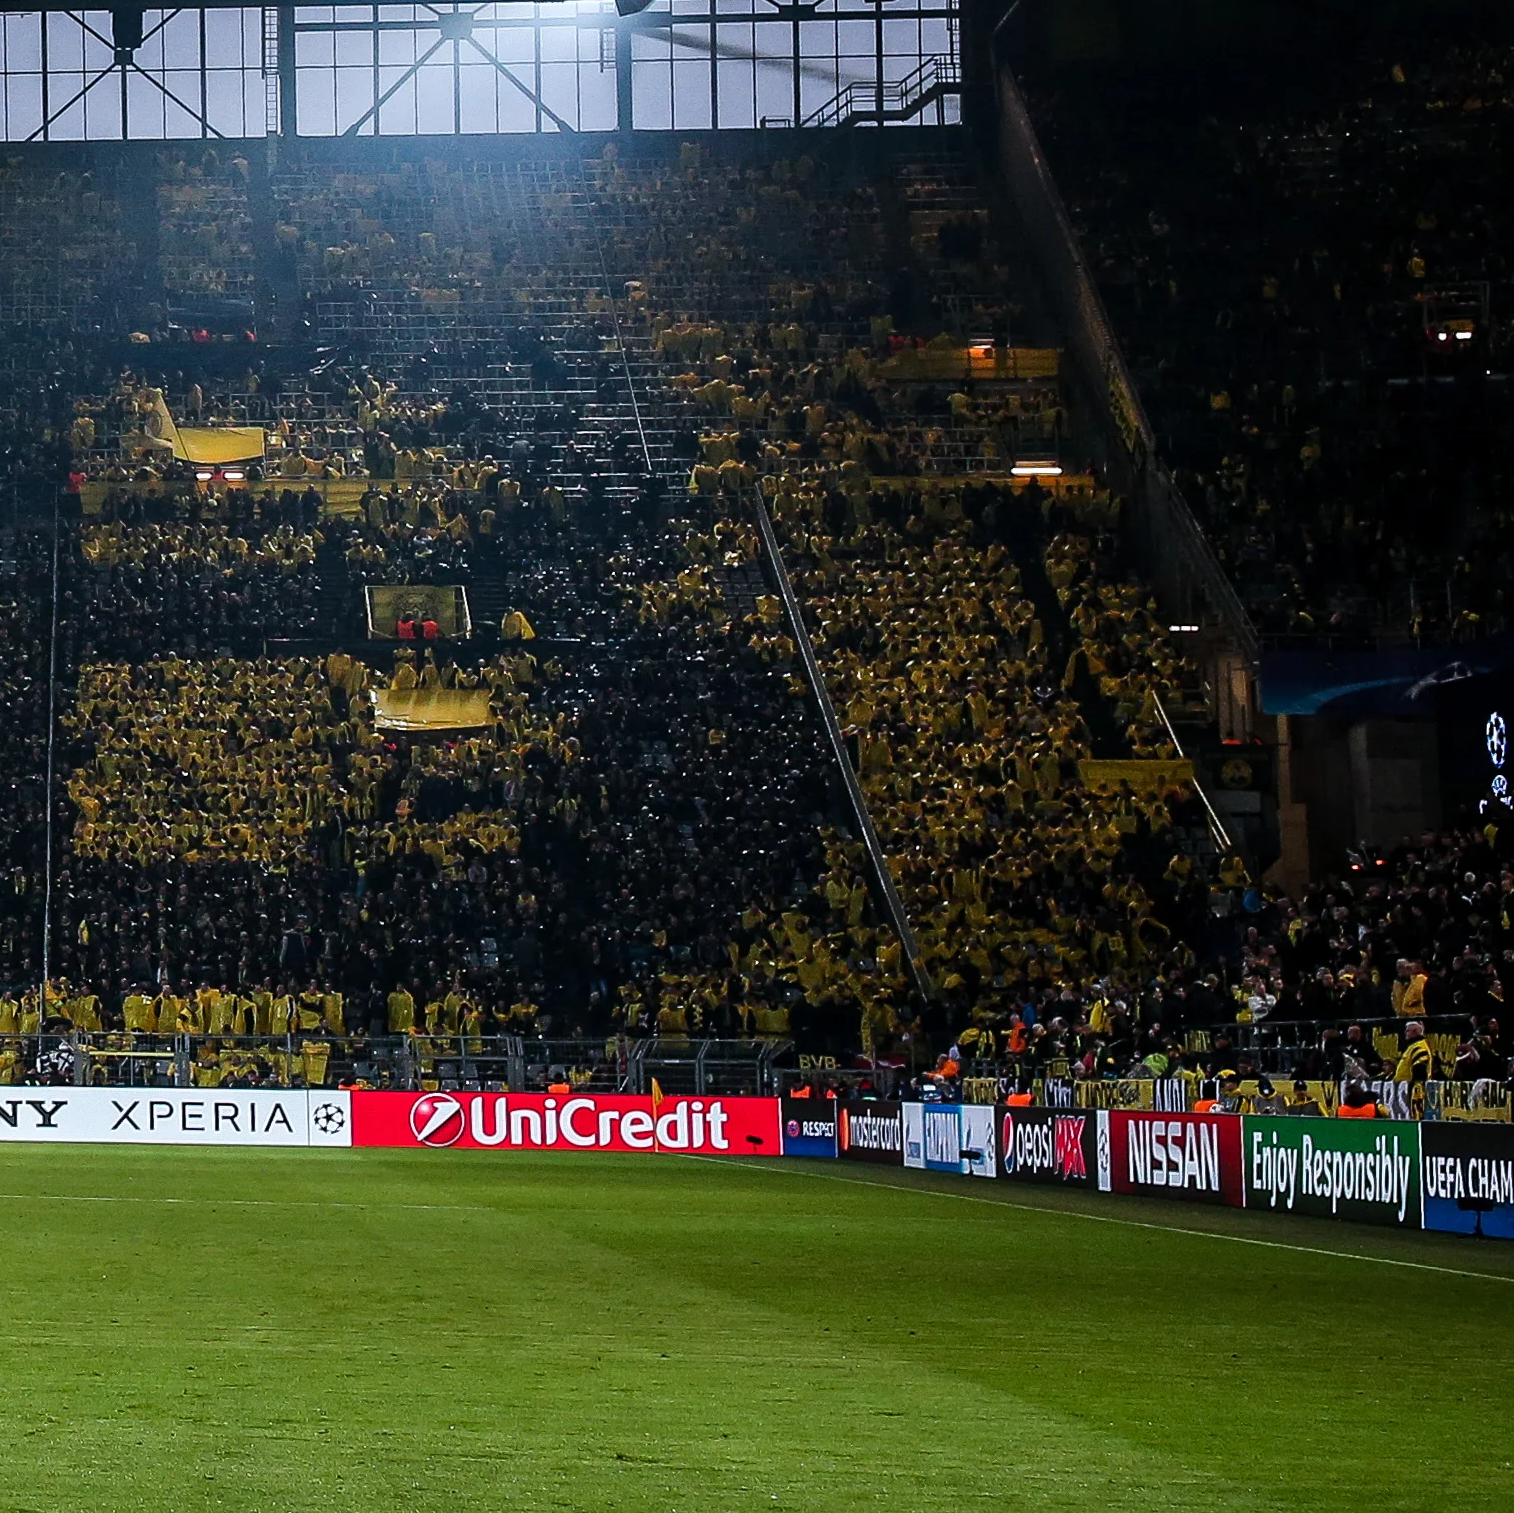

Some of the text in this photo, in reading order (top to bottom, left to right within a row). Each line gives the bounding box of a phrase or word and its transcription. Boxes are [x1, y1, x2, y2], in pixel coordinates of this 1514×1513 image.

[111, 1100, 293, 1133] XPERIA
[472, 1095, 730, 1149] UniCredit
[802, 1121, 835, 1137] RESPECT
[850, 1109, 901, 1151] mastercard
[1016, 1117, 1053, 1174] pepsi
[1128, 1119, 1220, 1192] NISSAN
[1252, 1131, 1411, 1222] Enjoy Responsibly
[1426, 1156, 1465, 1199] UEFA
